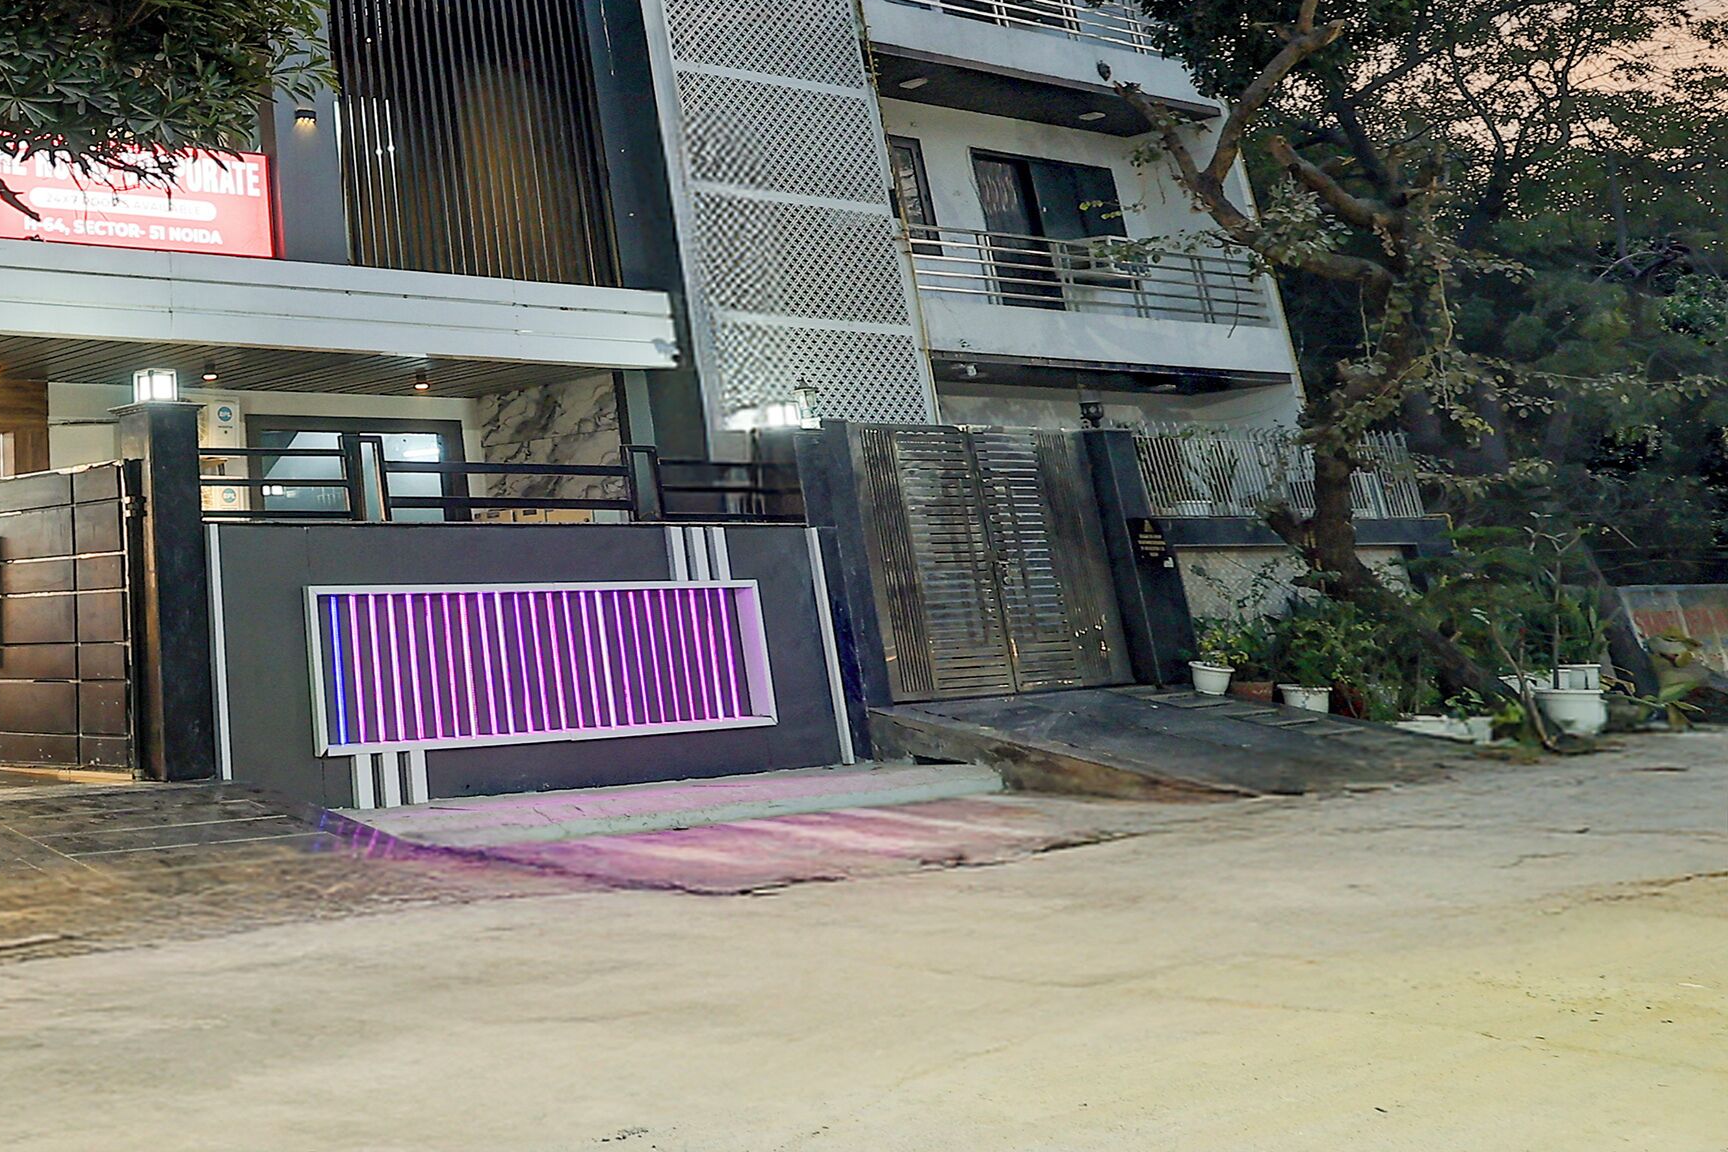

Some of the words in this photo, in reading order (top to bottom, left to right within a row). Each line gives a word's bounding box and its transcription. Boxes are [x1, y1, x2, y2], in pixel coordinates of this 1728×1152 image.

[73, 219, 146, 238] SECTOR-
[149, 224, 166, 240] 51
[169, 226, 223, 244] NOIDA
